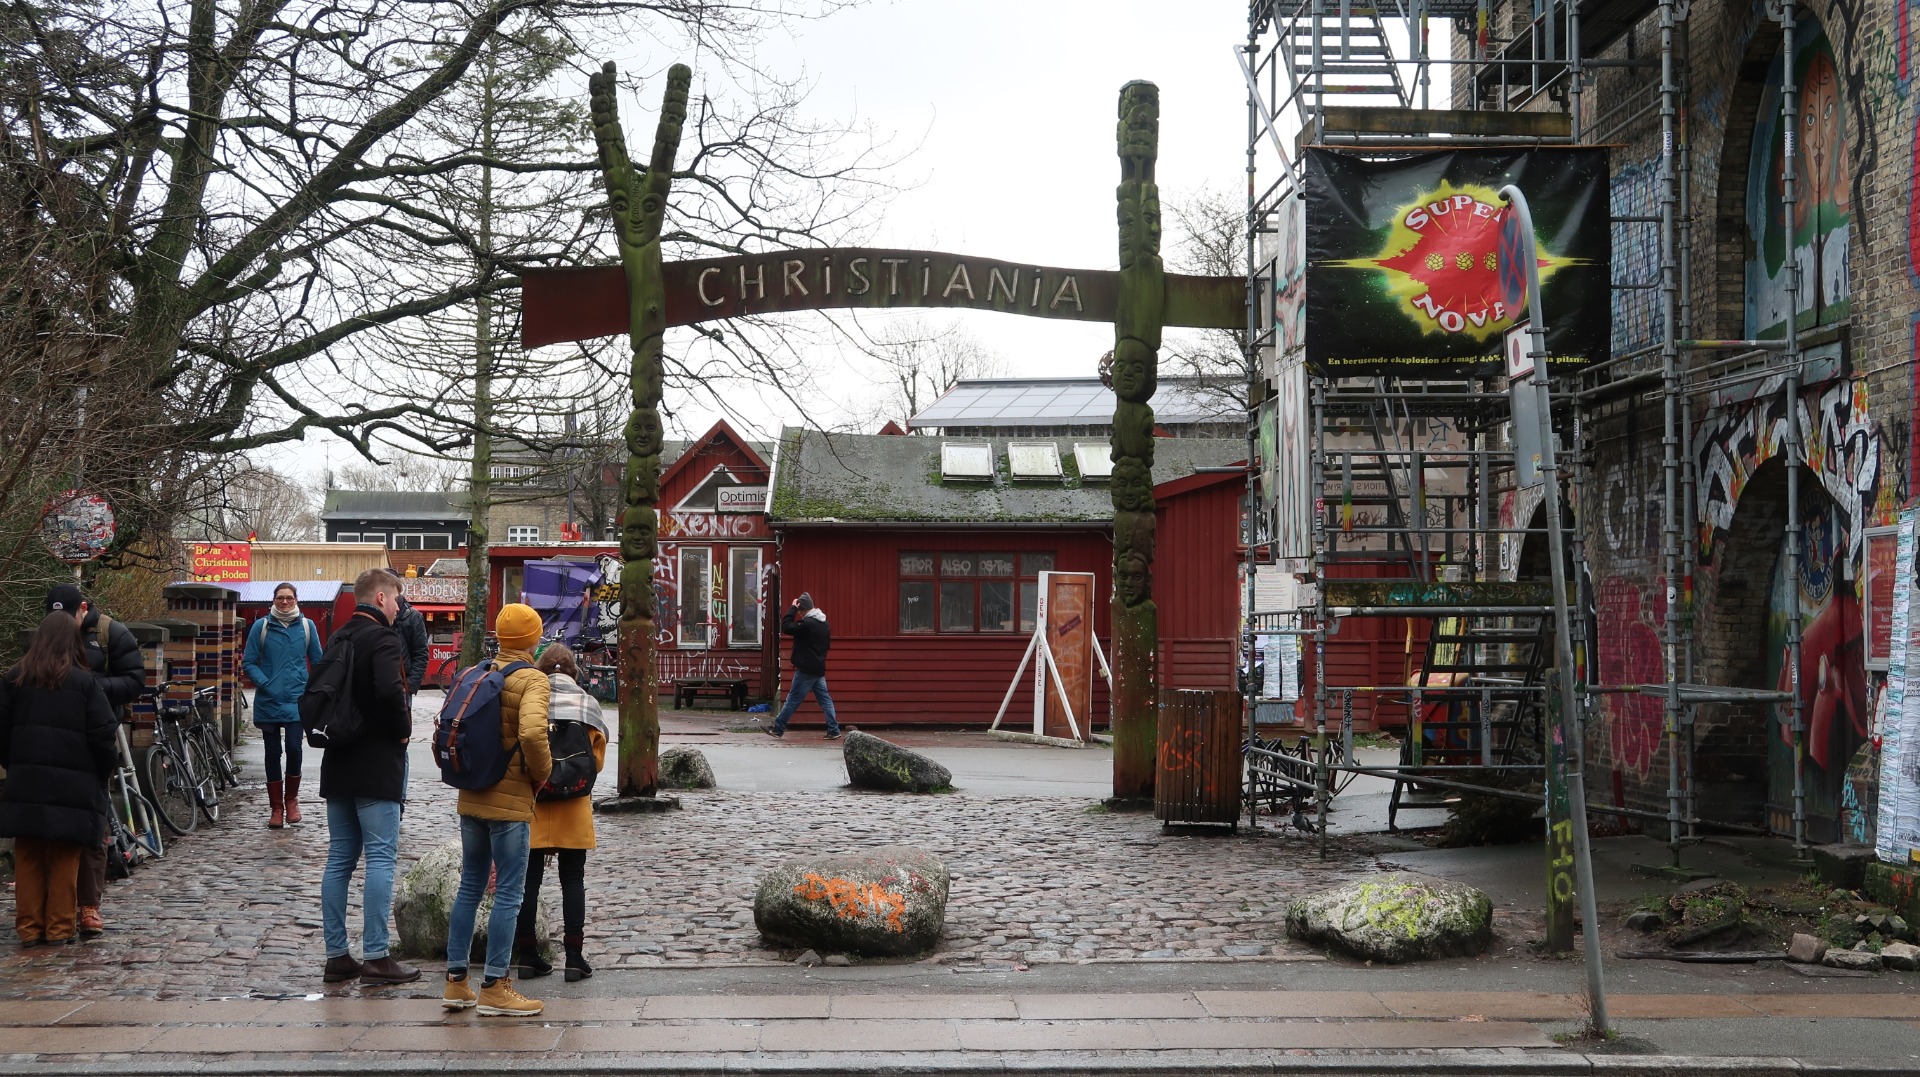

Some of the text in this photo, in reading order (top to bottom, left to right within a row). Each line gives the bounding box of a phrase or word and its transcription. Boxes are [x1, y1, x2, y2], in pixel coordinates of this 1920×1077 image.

[1328, 357, 1341, 365] En
[1343, 356, 1388, 365] berusende
[1390, 356, 1439, 365] eksplosion
[1441, 356, 1451, 364] af
[1452, 355, 1478, 364] smag!
[1480, 354, 1501, 363] 4,6%
[1556, 355, 1591, 364] pilsner.
[720, 490, 768, 504] Optimis
[195, 545, 222, 555] Bevar
[194, 557, 249, 567] Christiania
[222, 569, 249, 579] Boden
[433, 648, 452, 660] Shop
